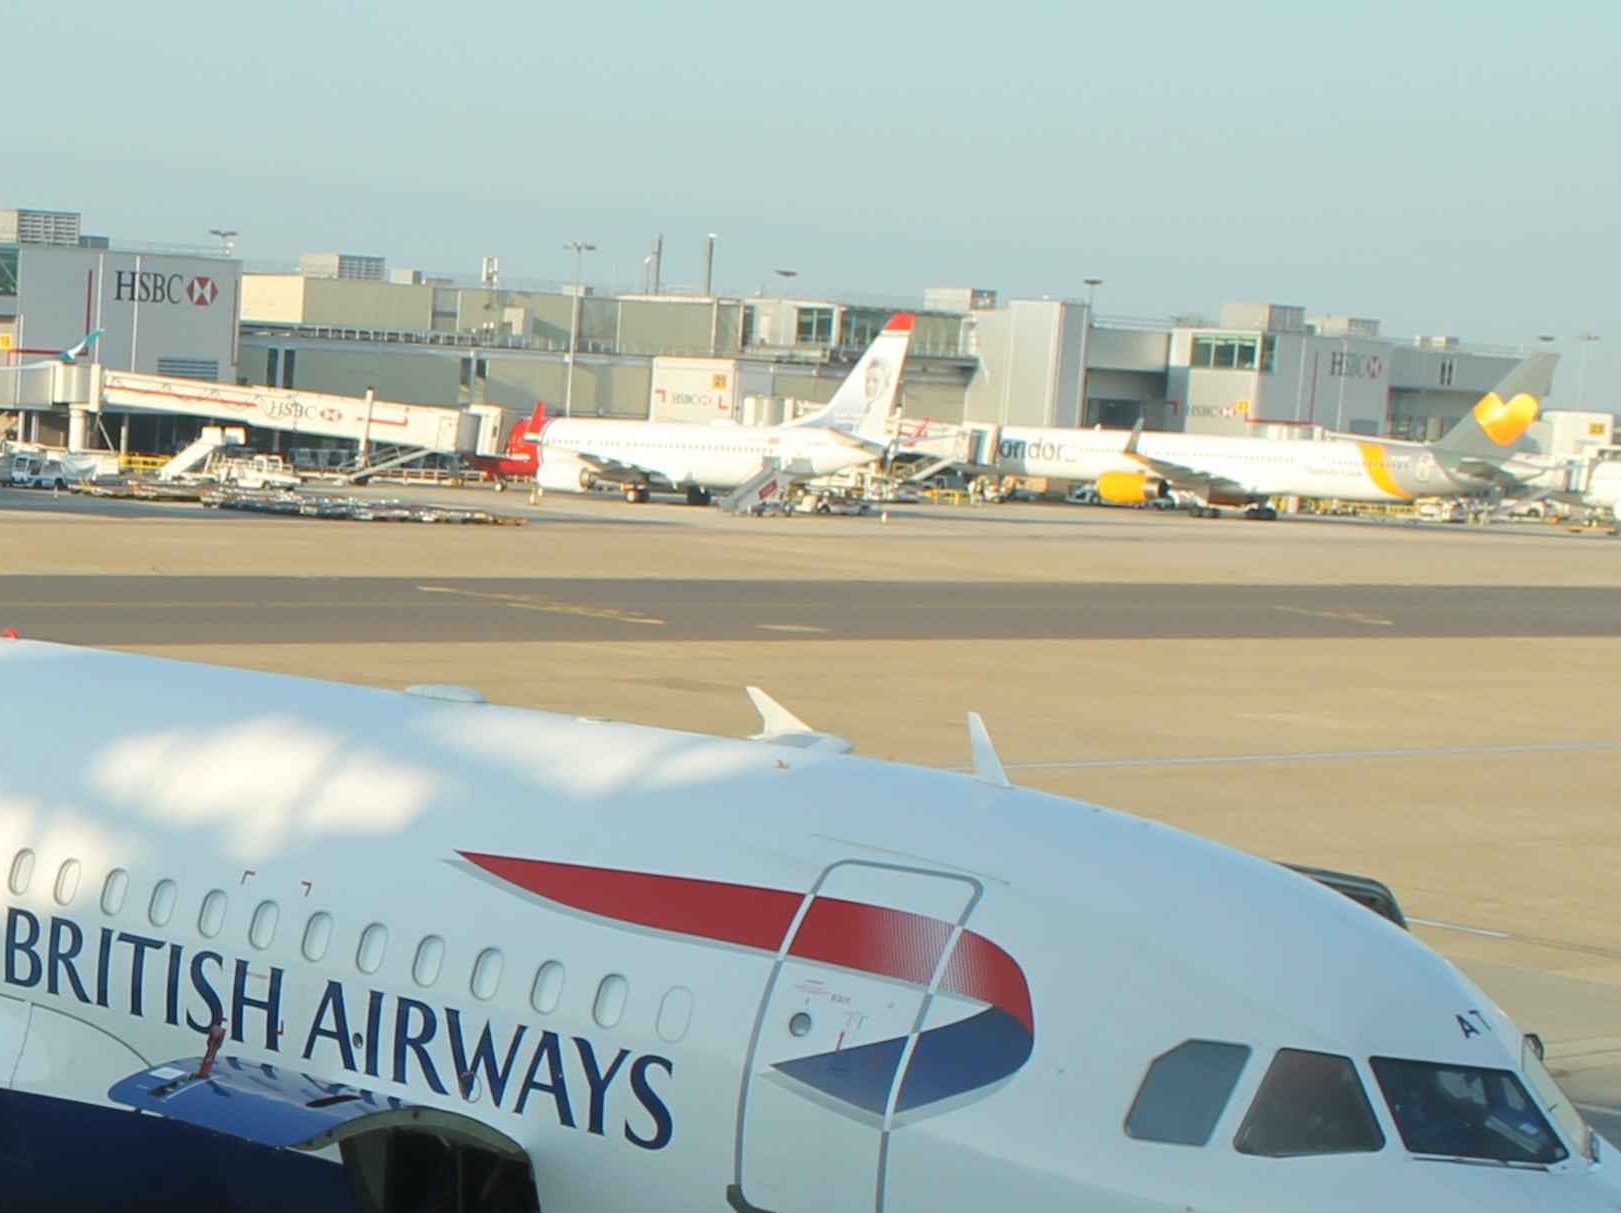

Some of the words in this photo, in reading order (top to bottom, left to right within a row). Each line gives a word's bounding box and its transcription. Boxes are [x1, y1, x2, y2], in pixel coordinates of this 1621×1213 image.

[115, 270, 184, 304] HSBC
[270, 400, 317, 419] HSBC
[830, 994, 852, 1005] EXIT
[4, 906, 285, 1052] BRITISH
[302, 980, 673, 1151] AIRWAYS
